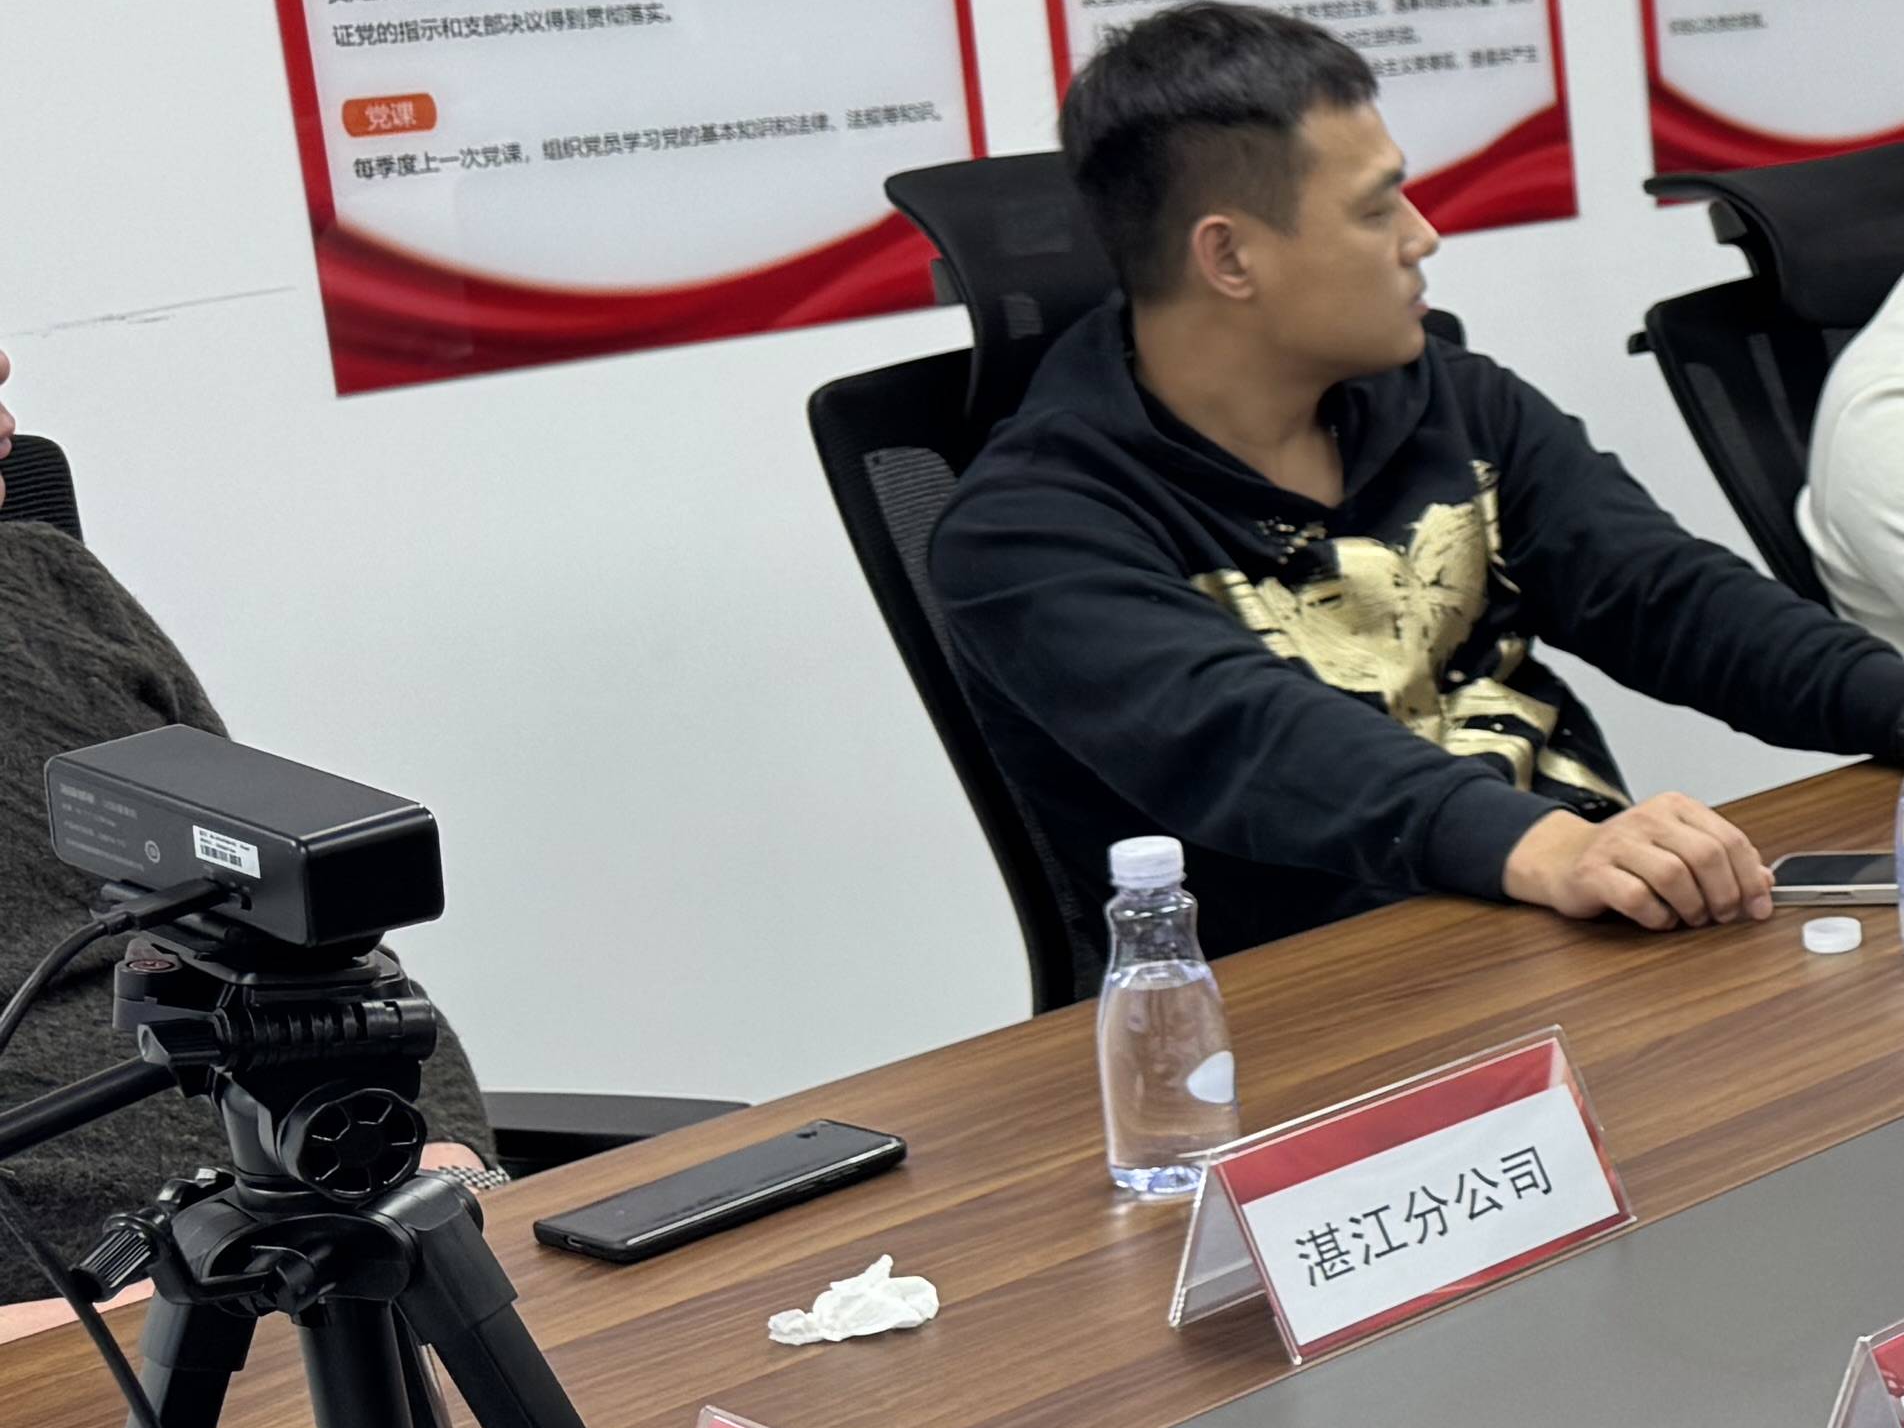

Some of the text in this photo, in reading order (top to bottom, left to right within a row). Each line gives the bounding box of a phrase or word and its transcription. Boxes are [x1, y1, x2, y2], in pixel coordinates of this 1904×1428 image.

[365, 101, 416, 130] 党课
[1295, 1145, 1553, 1287] 湛江分公司
